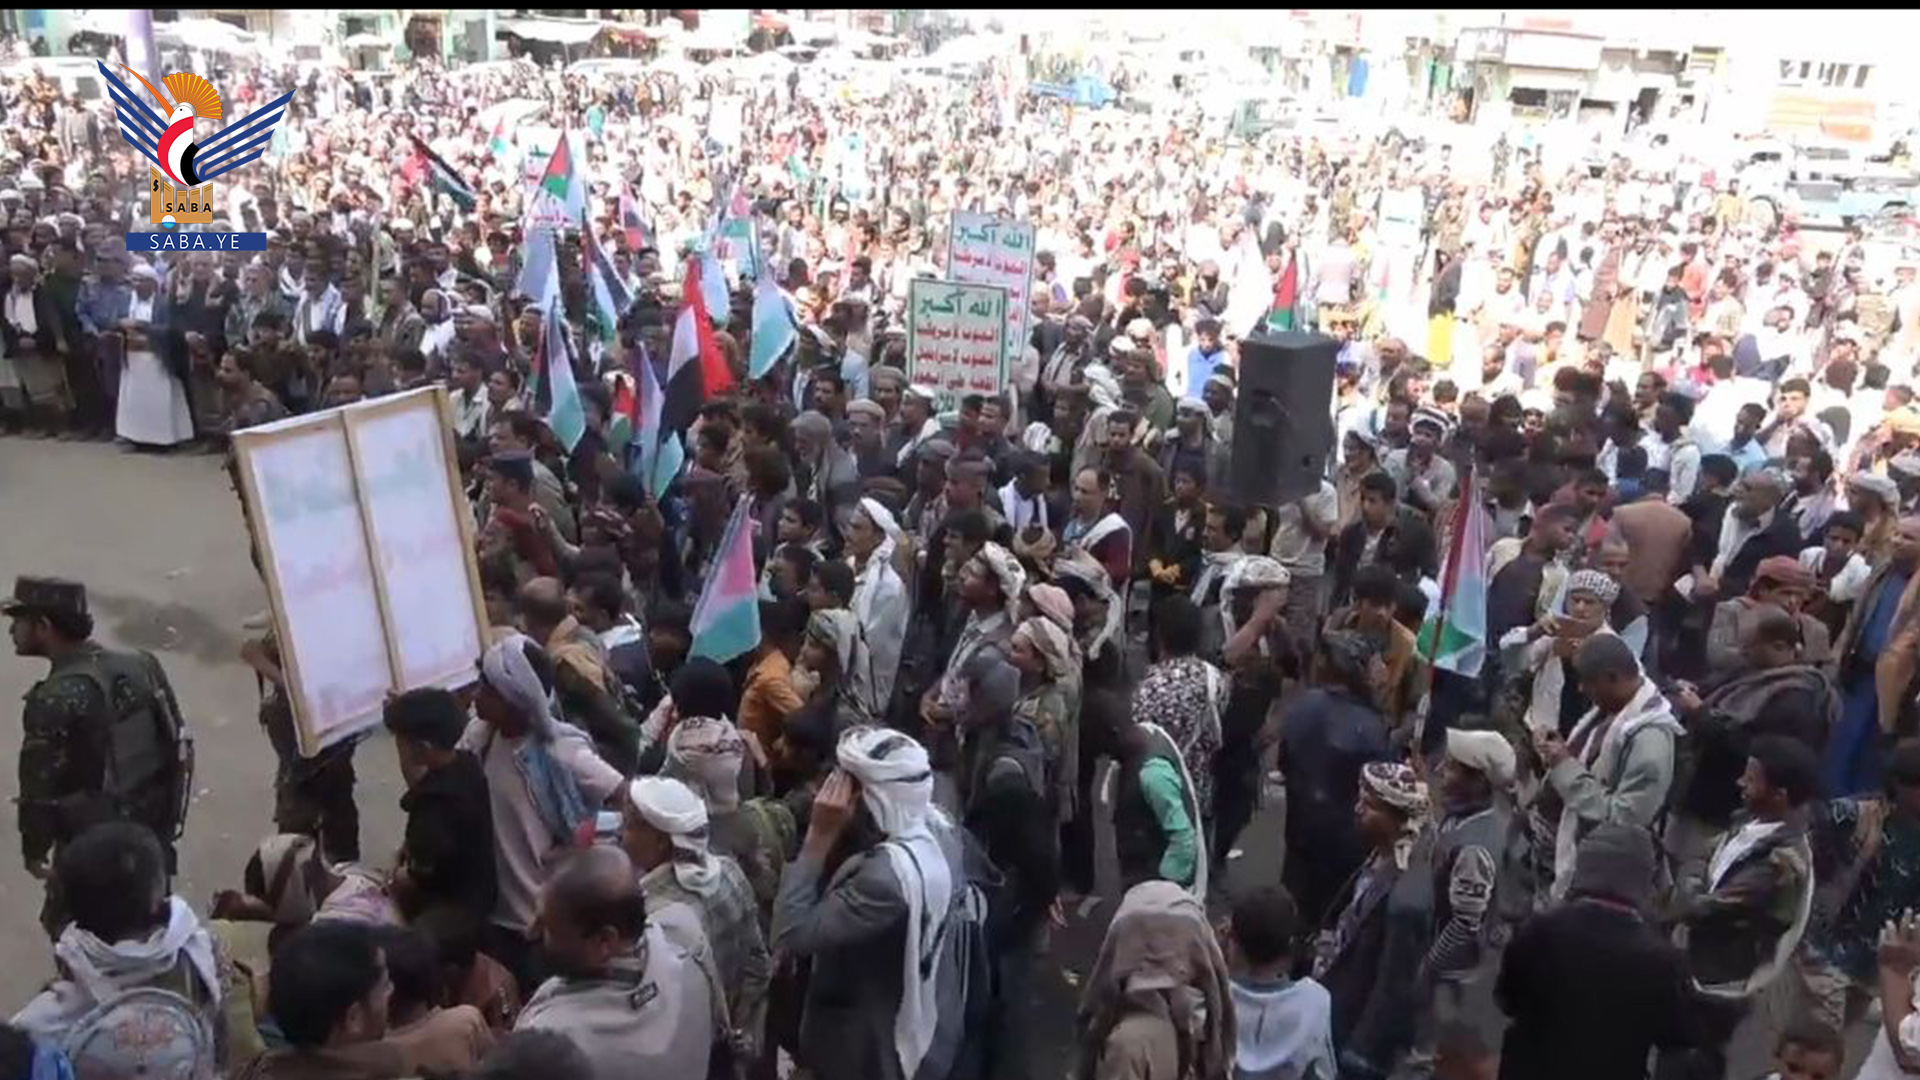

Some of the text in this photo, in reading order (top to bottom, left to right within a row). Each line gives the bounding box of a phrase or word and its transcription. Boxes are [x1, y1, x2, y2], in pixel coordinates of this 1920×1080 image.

[954, 218, 1030, 250] الله أكبر
[918, 288, 966, 319] أكبر
[968, 296, 1000, 318] الله
[961, 325, 999, 342] الموت
[961, 351, 998, 369] الموت
